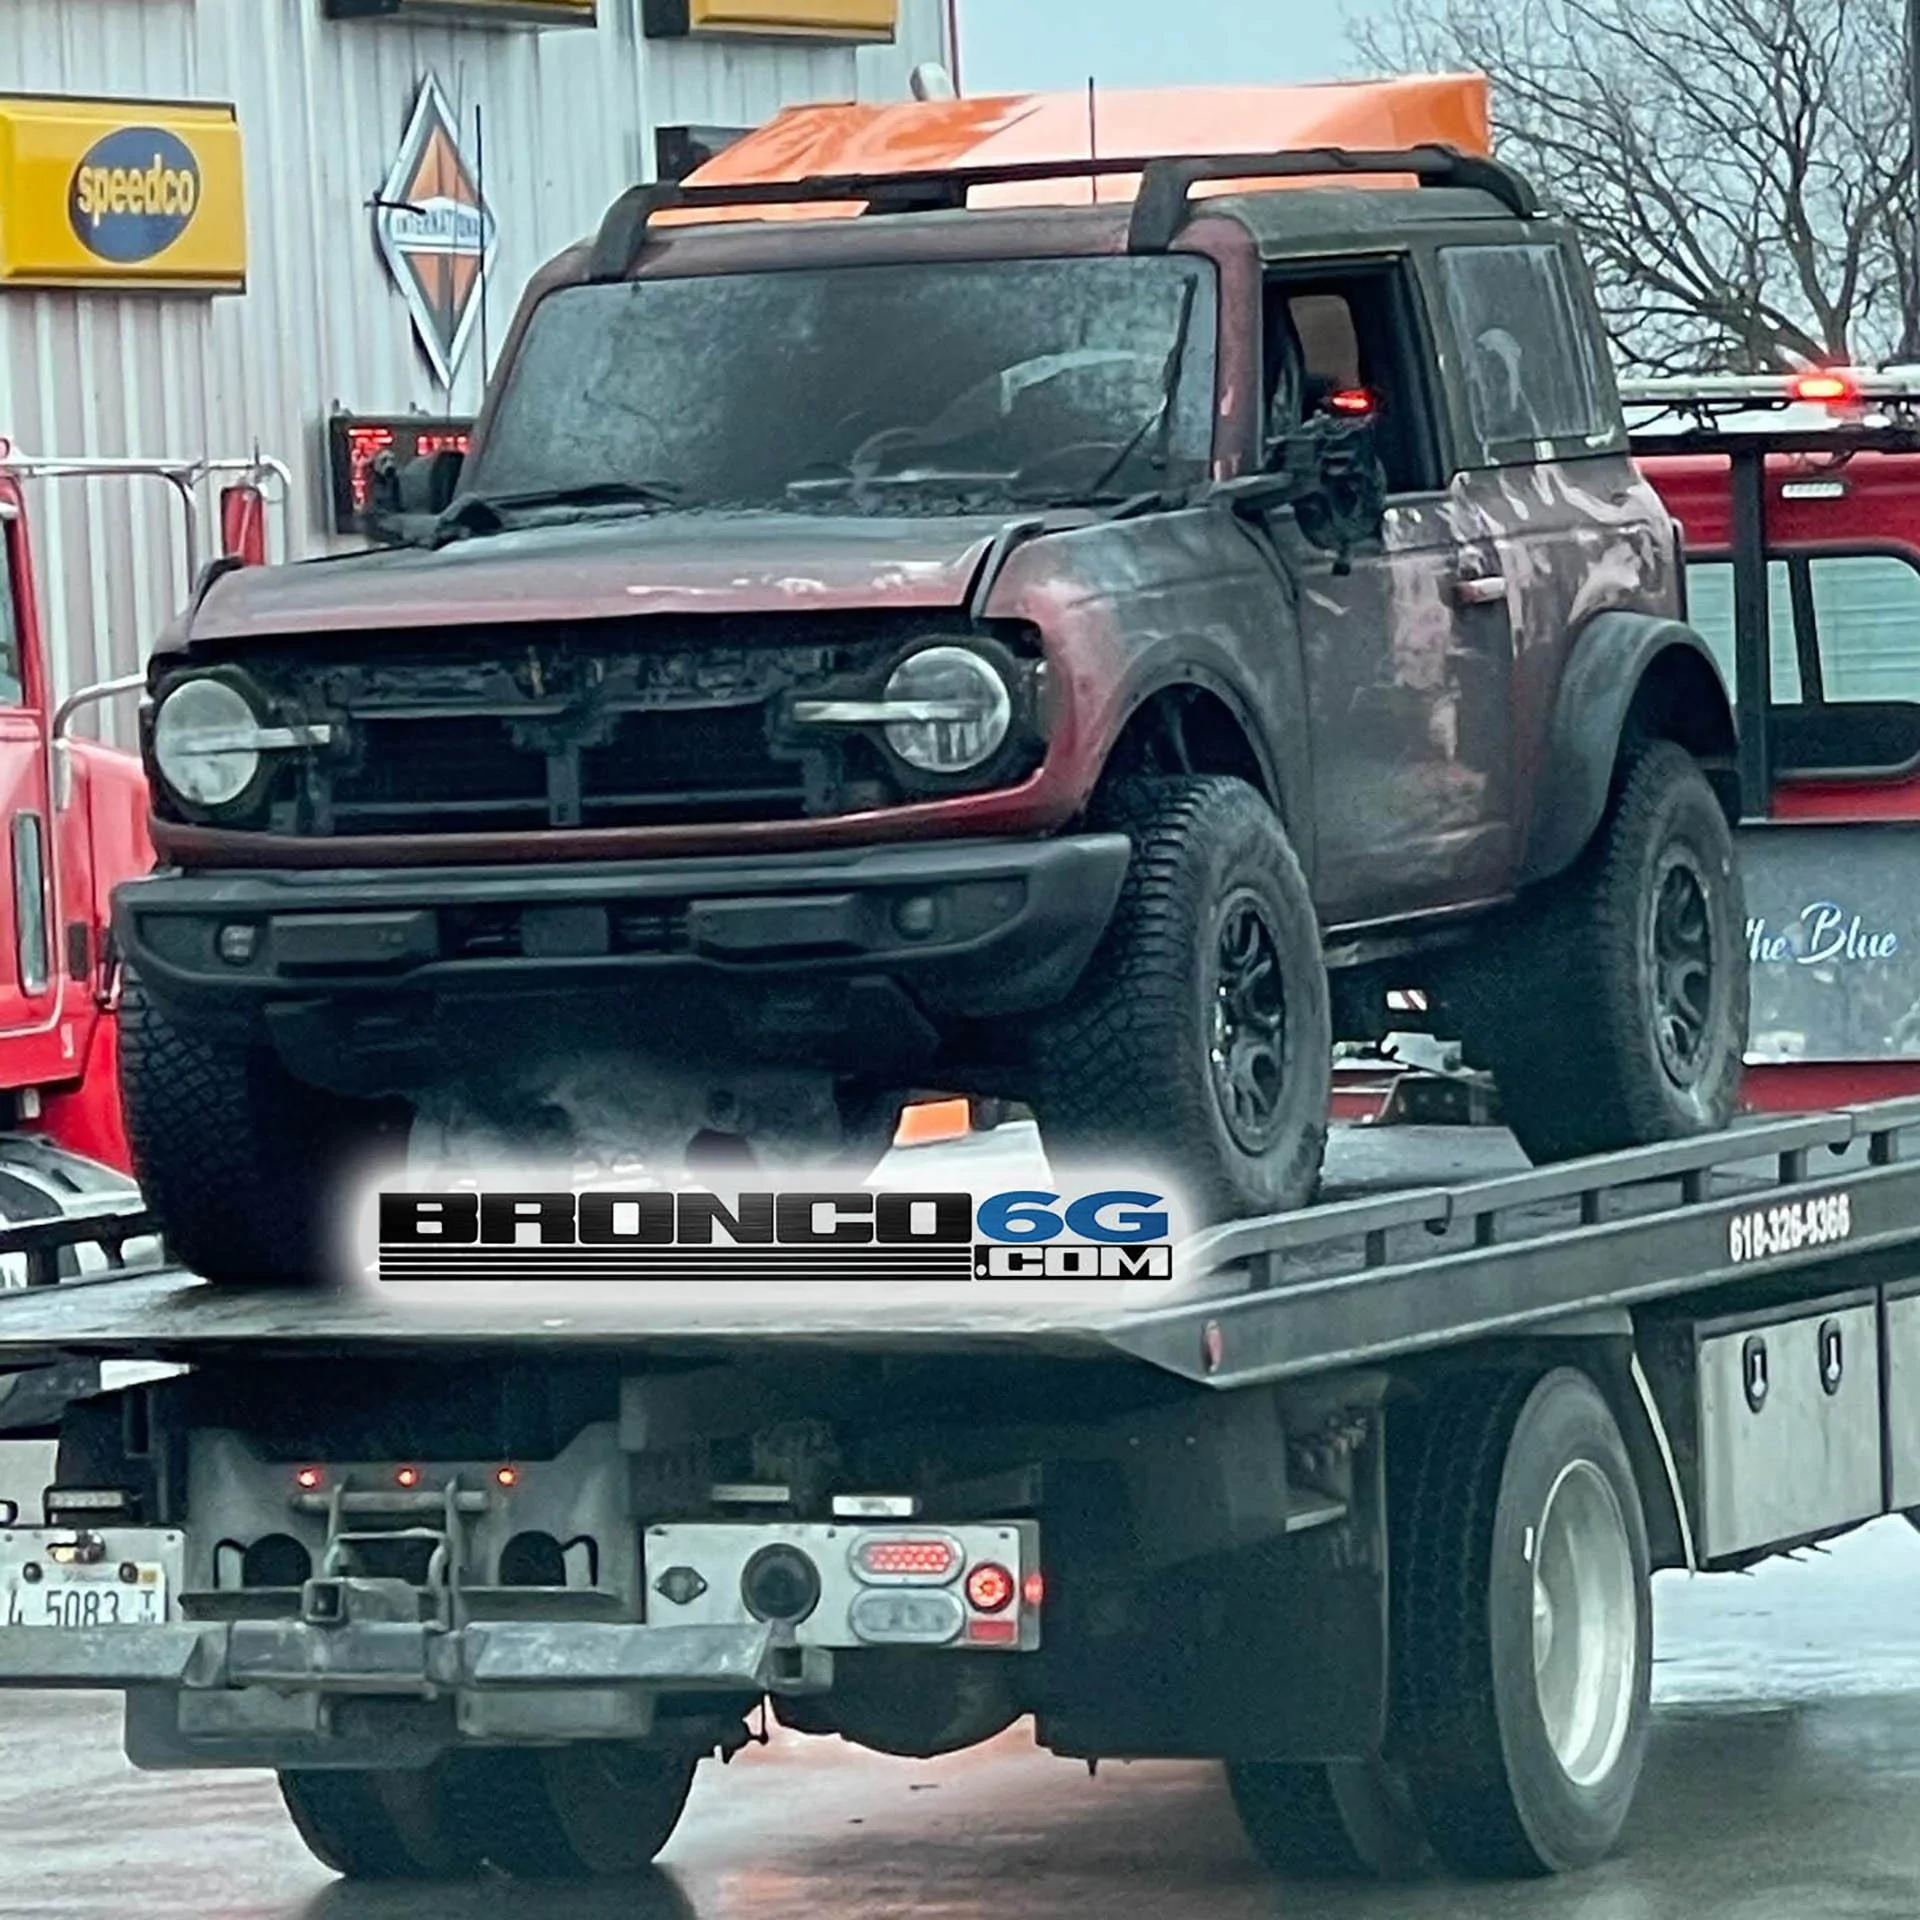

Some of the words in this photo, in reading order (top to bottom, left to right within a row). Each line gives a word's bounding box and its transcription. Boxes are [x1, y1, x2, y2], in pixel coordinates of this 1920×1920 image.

[78, 153, 195, 228] speedco
[396, 208, 485, 237] INTERNATONA
[1745, 917, 1788, 962] he
[1797, 901, 1898, 965] Blue
